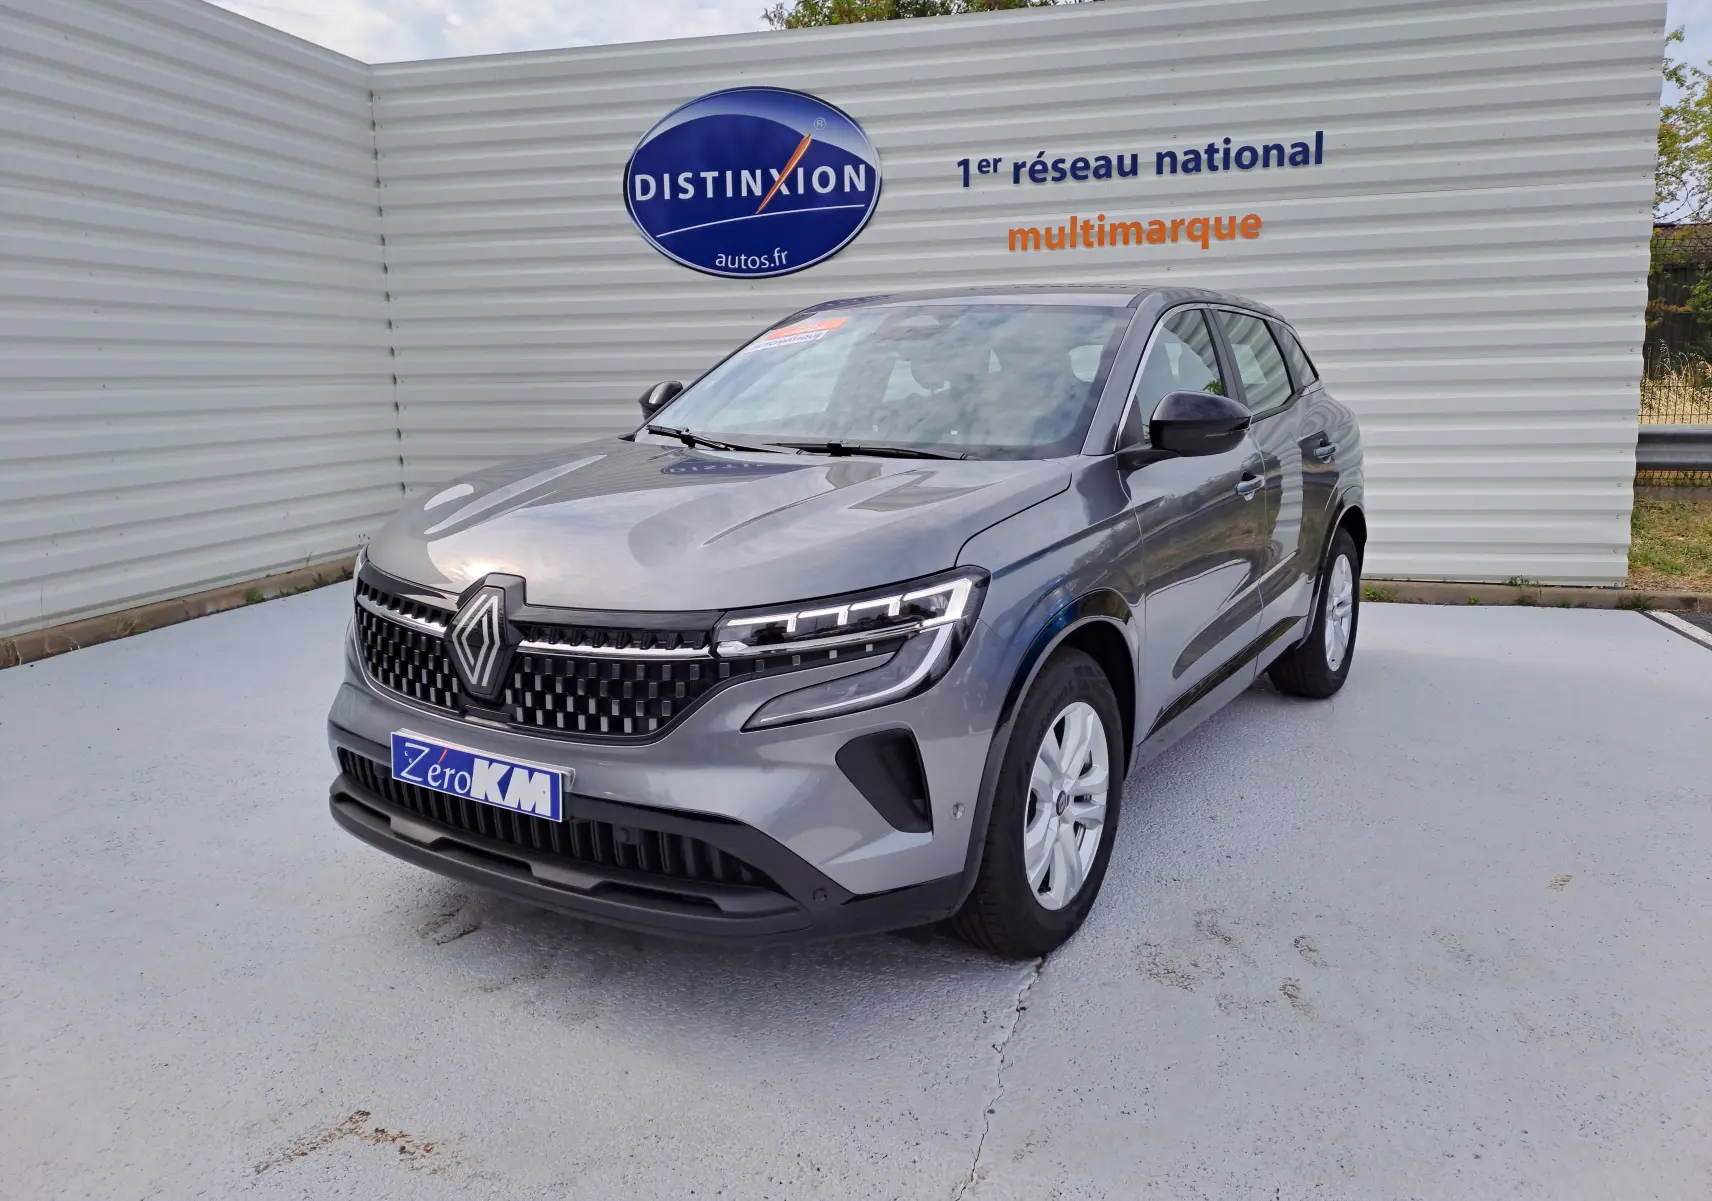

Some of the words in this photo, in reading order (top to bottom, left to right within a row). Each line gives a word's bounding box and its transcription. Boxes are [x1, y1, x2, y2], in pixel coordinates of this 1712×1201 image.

[957, 155, 1002, 188] 1er
[1012, 151, 1139, 185] réseau
[1155, 131, 1324, 175] national
[635, 164, 866, 201] DISTINXION
[1008, 213, 1263, 251] multimarque
[715, 247, 788, 269] autos.fr
